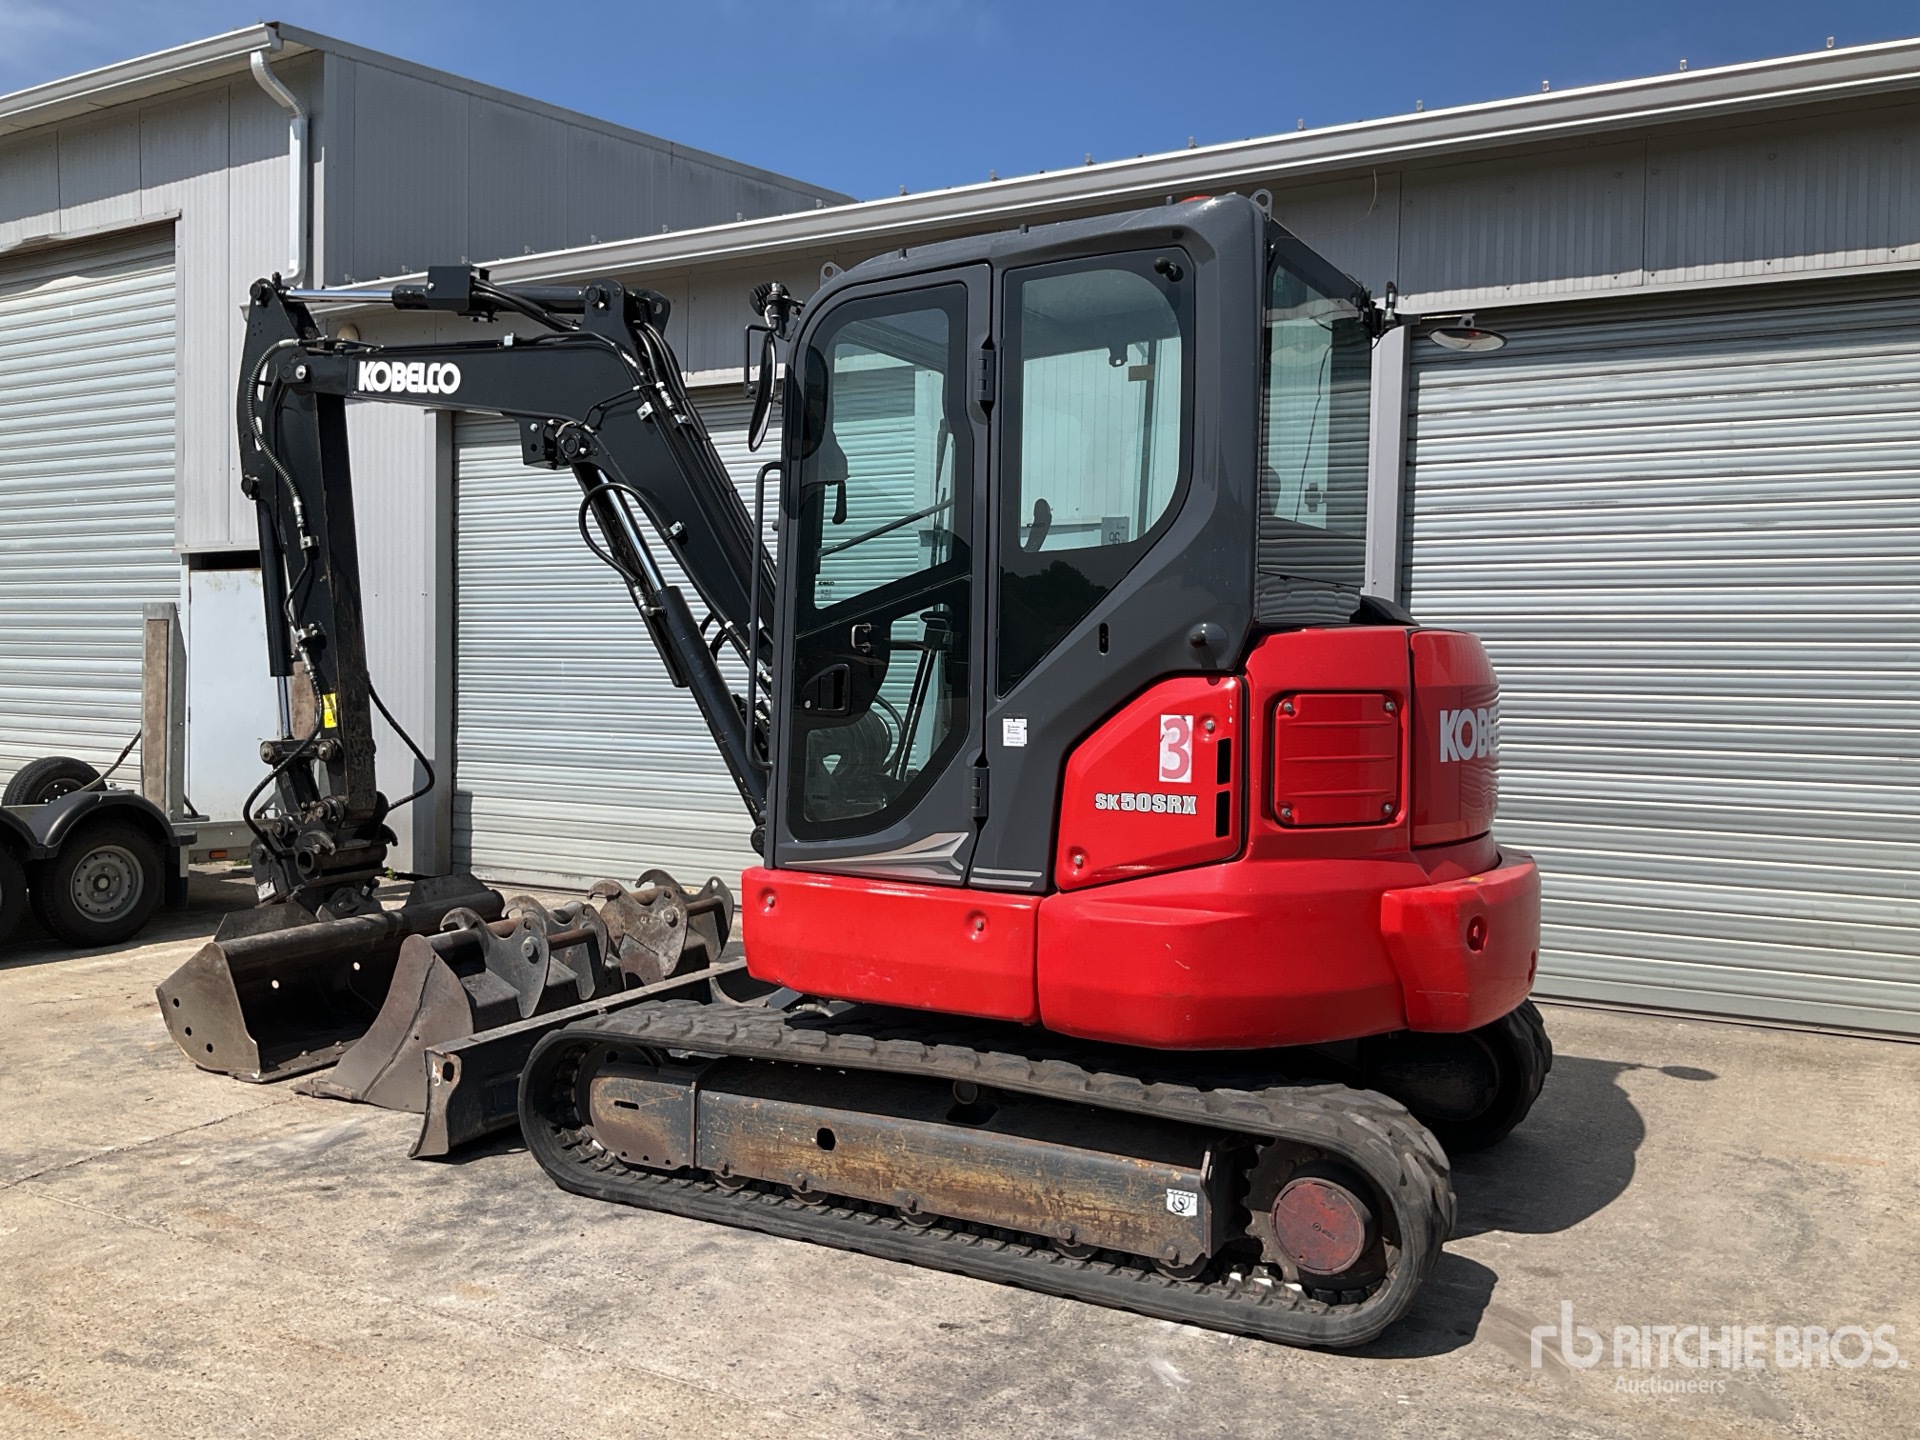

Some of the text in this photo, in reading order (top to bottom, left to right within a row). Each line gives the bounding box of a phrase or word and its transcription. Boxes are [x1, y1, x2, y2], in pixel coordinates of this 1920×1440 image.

[358, 361, 461, 394] KOBELCO
[1161, 717, 1190, 779] 3
[1440, 708, 1499, 762] KOBE
[1094, 791, 1198, 815] SK50SRX
